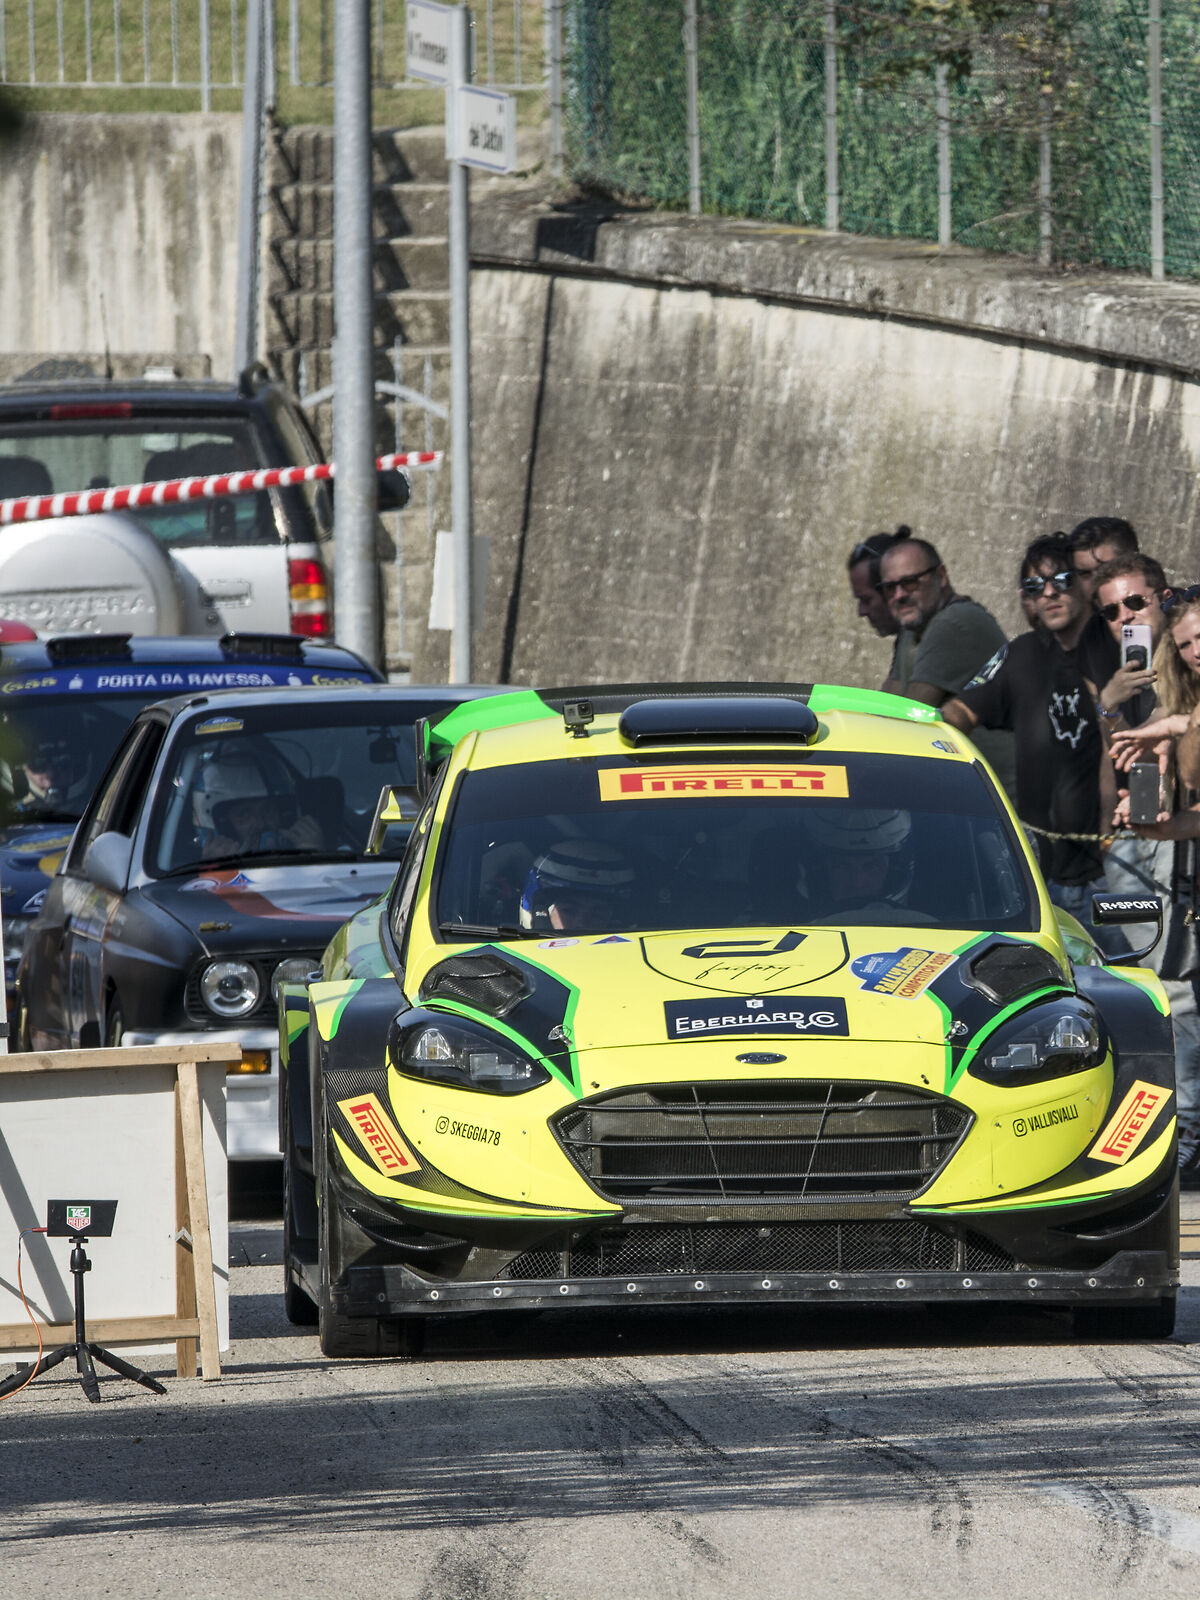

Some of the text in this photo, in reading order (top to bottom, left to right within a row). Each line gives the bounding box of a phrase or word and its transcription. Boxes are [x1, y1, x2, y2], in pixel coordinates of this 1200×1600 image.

[97, 672, 275, 689] PORTA DA RAVESSA
[619, 769, 826, 793] PIRELLI
[675, 1011, 805, 1033] EBERHARD
[349, 1102, 409, 1169] PIRELLI
[450, 1120, 501, 1146] SKEGGIA78
[1100, 1090, 1160, 1158] PIRELLI
